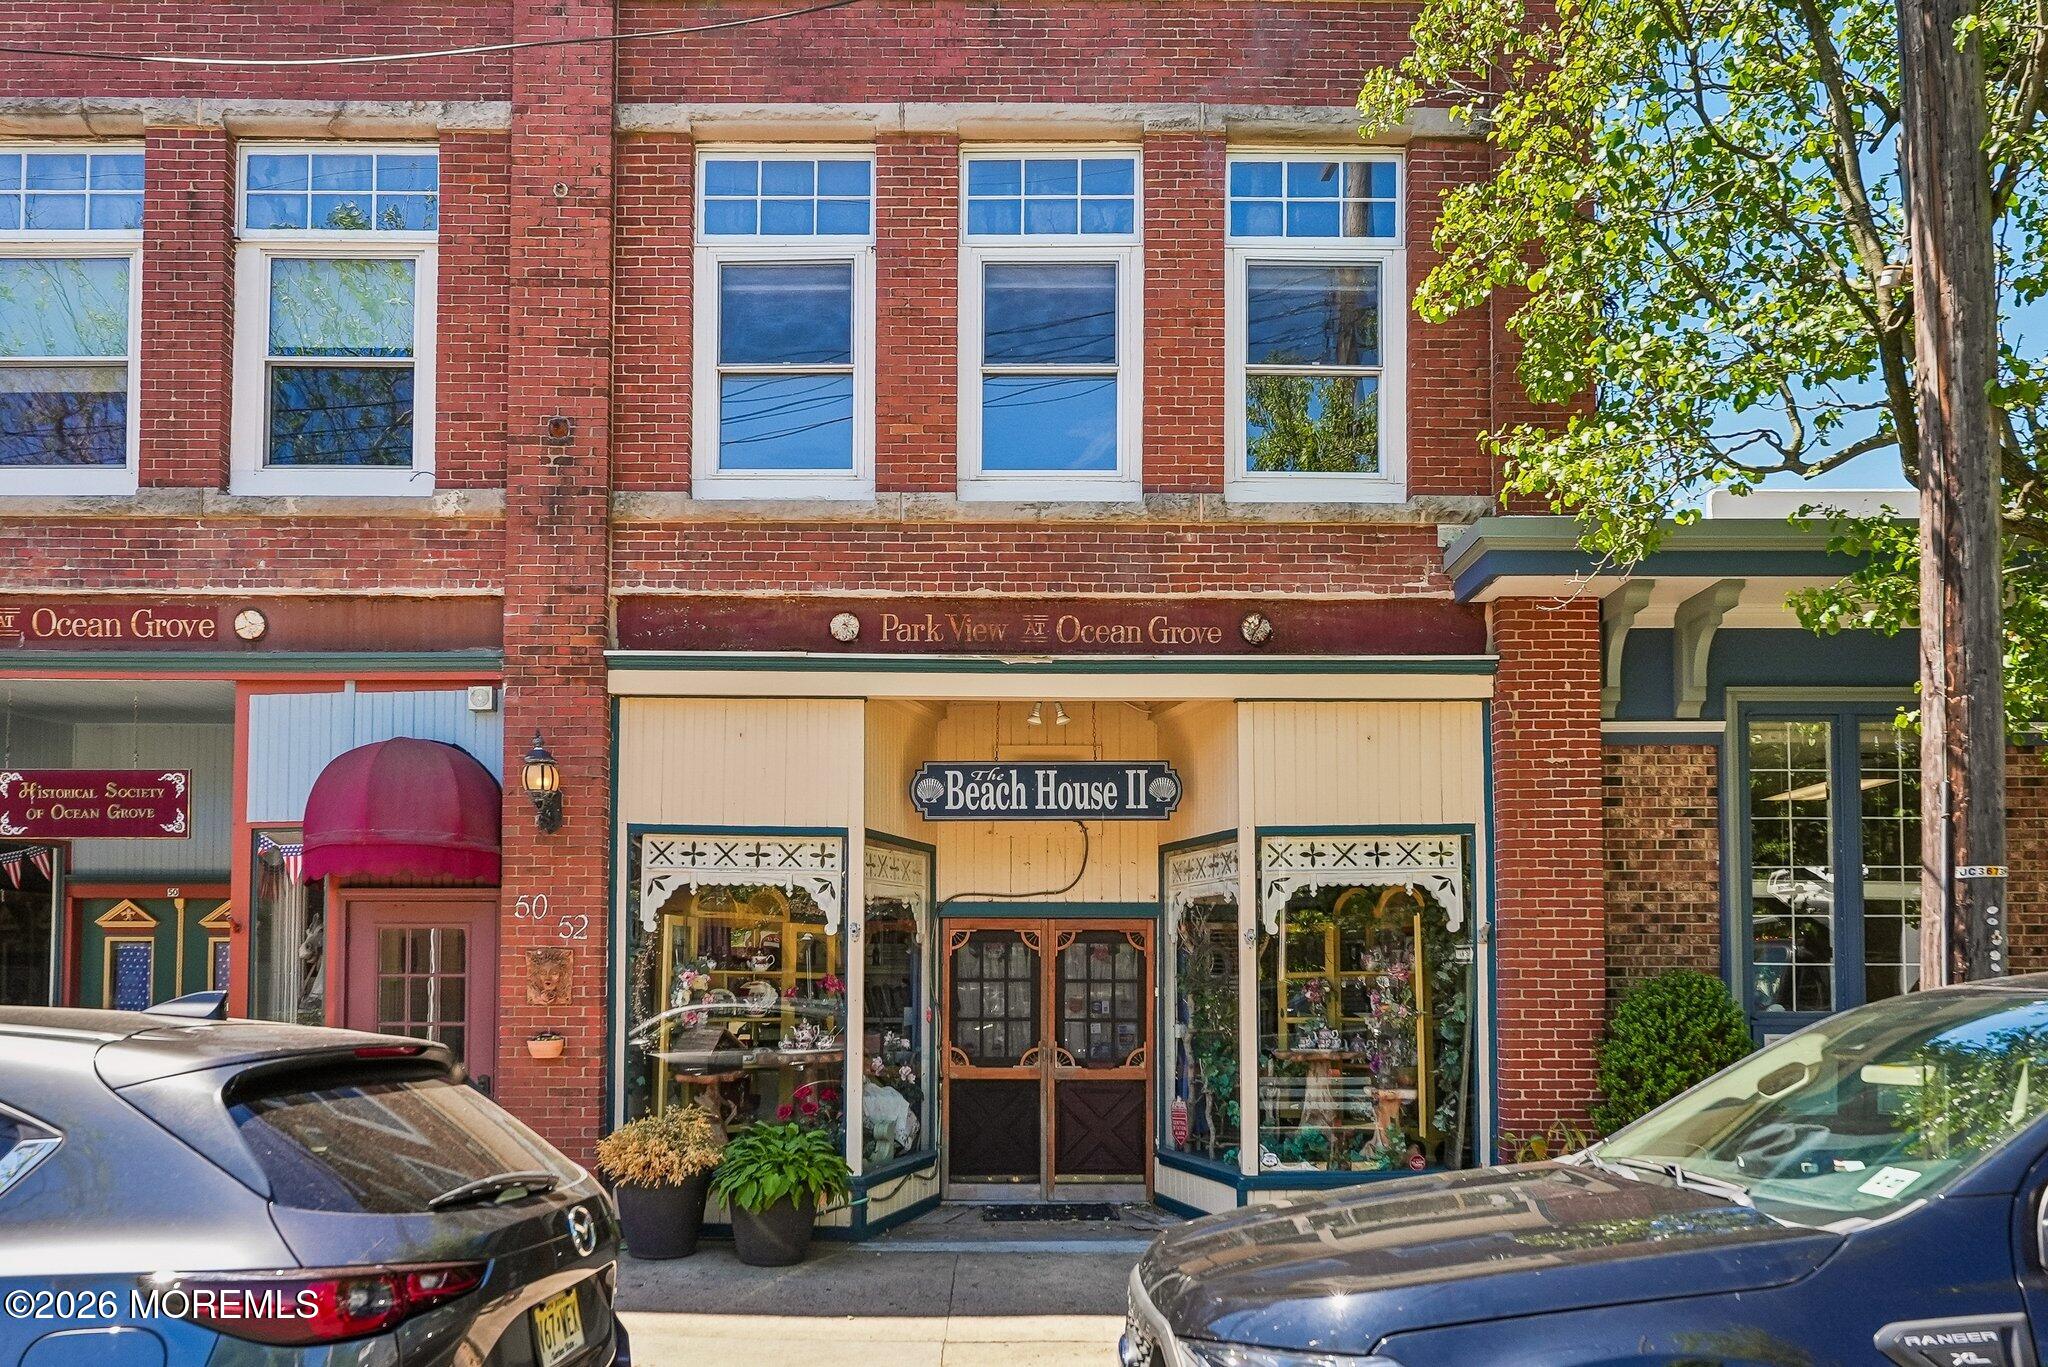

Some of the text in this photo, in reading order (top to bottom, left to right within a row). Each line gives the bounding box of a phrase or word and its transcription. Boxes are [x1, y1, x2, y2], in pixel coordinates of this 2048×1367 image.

[31, 608, 123, 638] Ocean
[130, 608, 216, 639] Grove
[879, 613, 945, 643] Park
[944, 613, 1009, 643] View
[1056, 614, 1144, 644] Ocean
[1148, 615, 1223, 645] Grove
[970, 766, 1005, 782] The
[944, 769, 1149, 811] Beach House II
[513, 893, 549, 920] 50
[558, 914, 590, 940] 52
[1903, 1330, 1999, 1347] RANGER
[1950, 1351, 1993, 1367] XL
